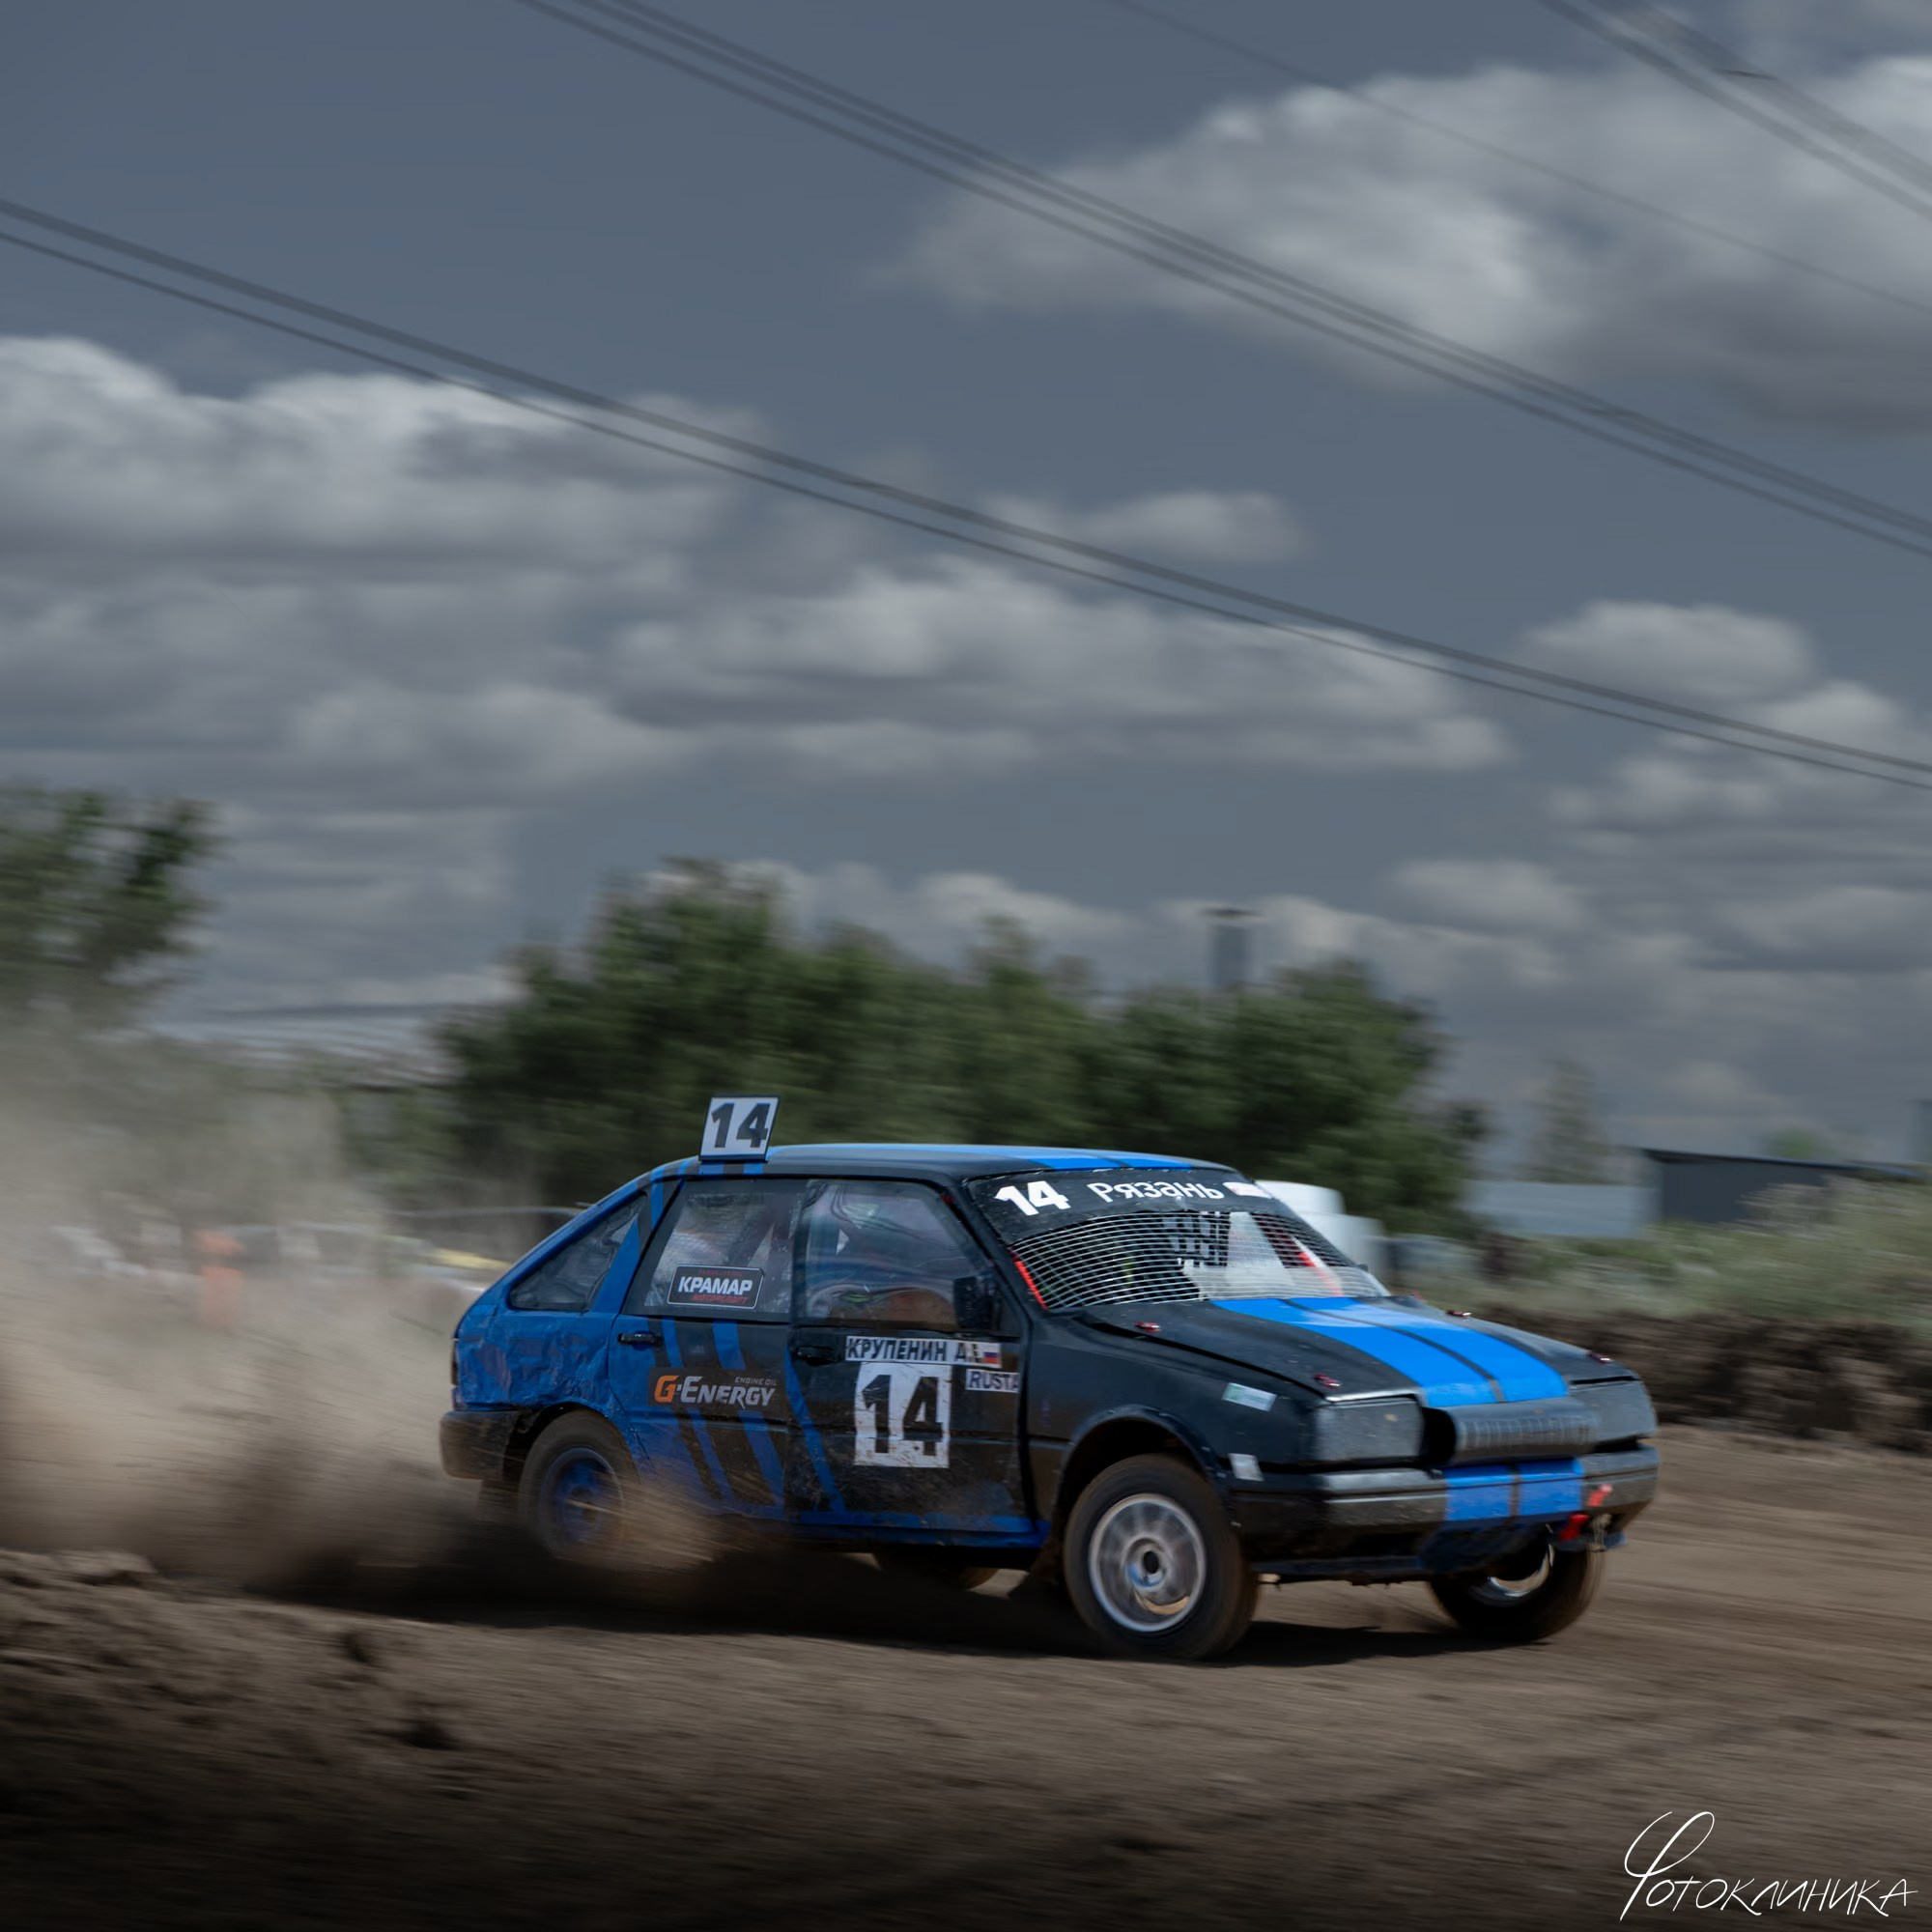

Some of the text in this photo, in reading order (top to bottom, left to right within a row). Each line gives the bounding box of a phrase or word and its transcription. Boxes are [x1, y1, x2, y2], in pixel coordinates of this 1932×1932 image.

[711, 1102, 771, 1149] 14
[994, 1180, 1071, 1215] 14
[1087, 1181, 1224, 1203] Рязань
[677, 1276, 753, 1295] КРАМАР
[847, 1338, 946, 1361] КРУПЕНИН
[734, 1377, 765, 1385] ENGINE
[862, 1375, 943, 1457] 14
